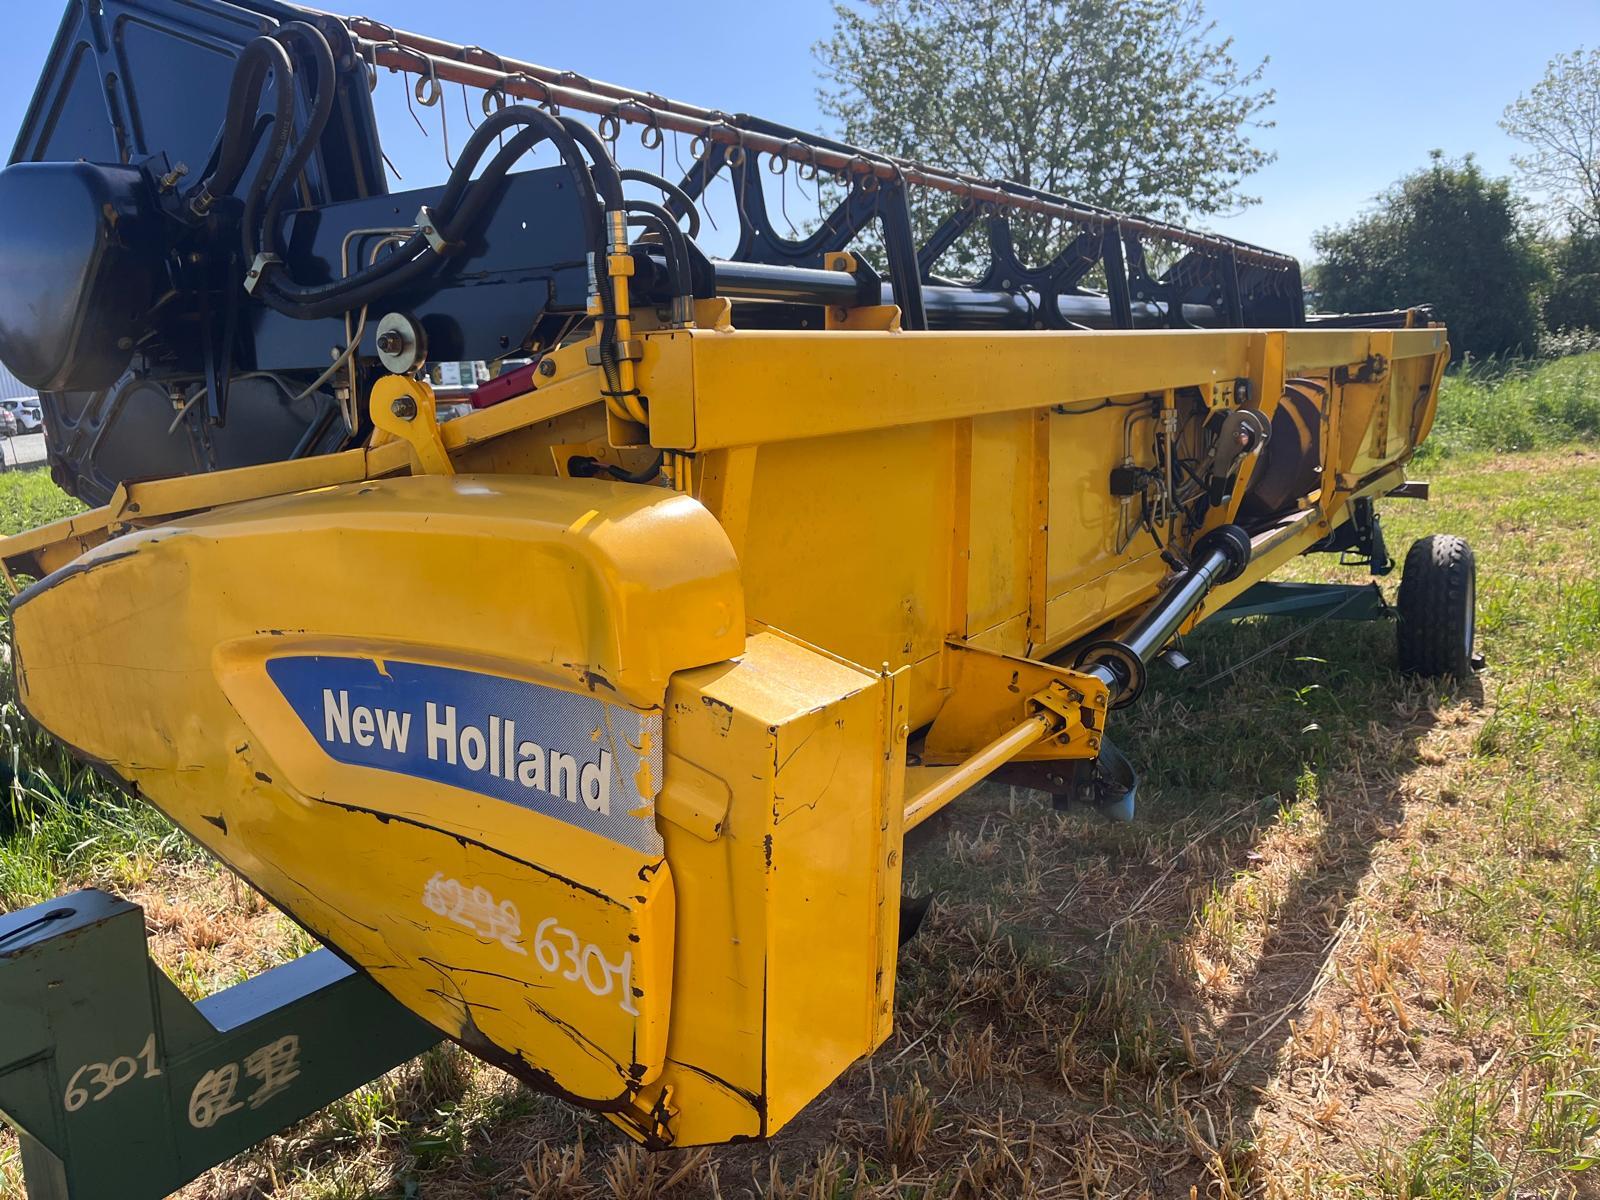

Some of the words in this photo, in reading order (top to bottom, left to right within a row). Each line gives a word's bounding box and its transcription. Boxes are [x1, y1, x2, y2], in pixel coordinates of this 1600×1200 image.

[322, 687, 411, 753] New
[425, 701, 612, 816] Holland
[534, 917, 640, 1016] 6301
[63, 1033, 163, 1112] 6301
